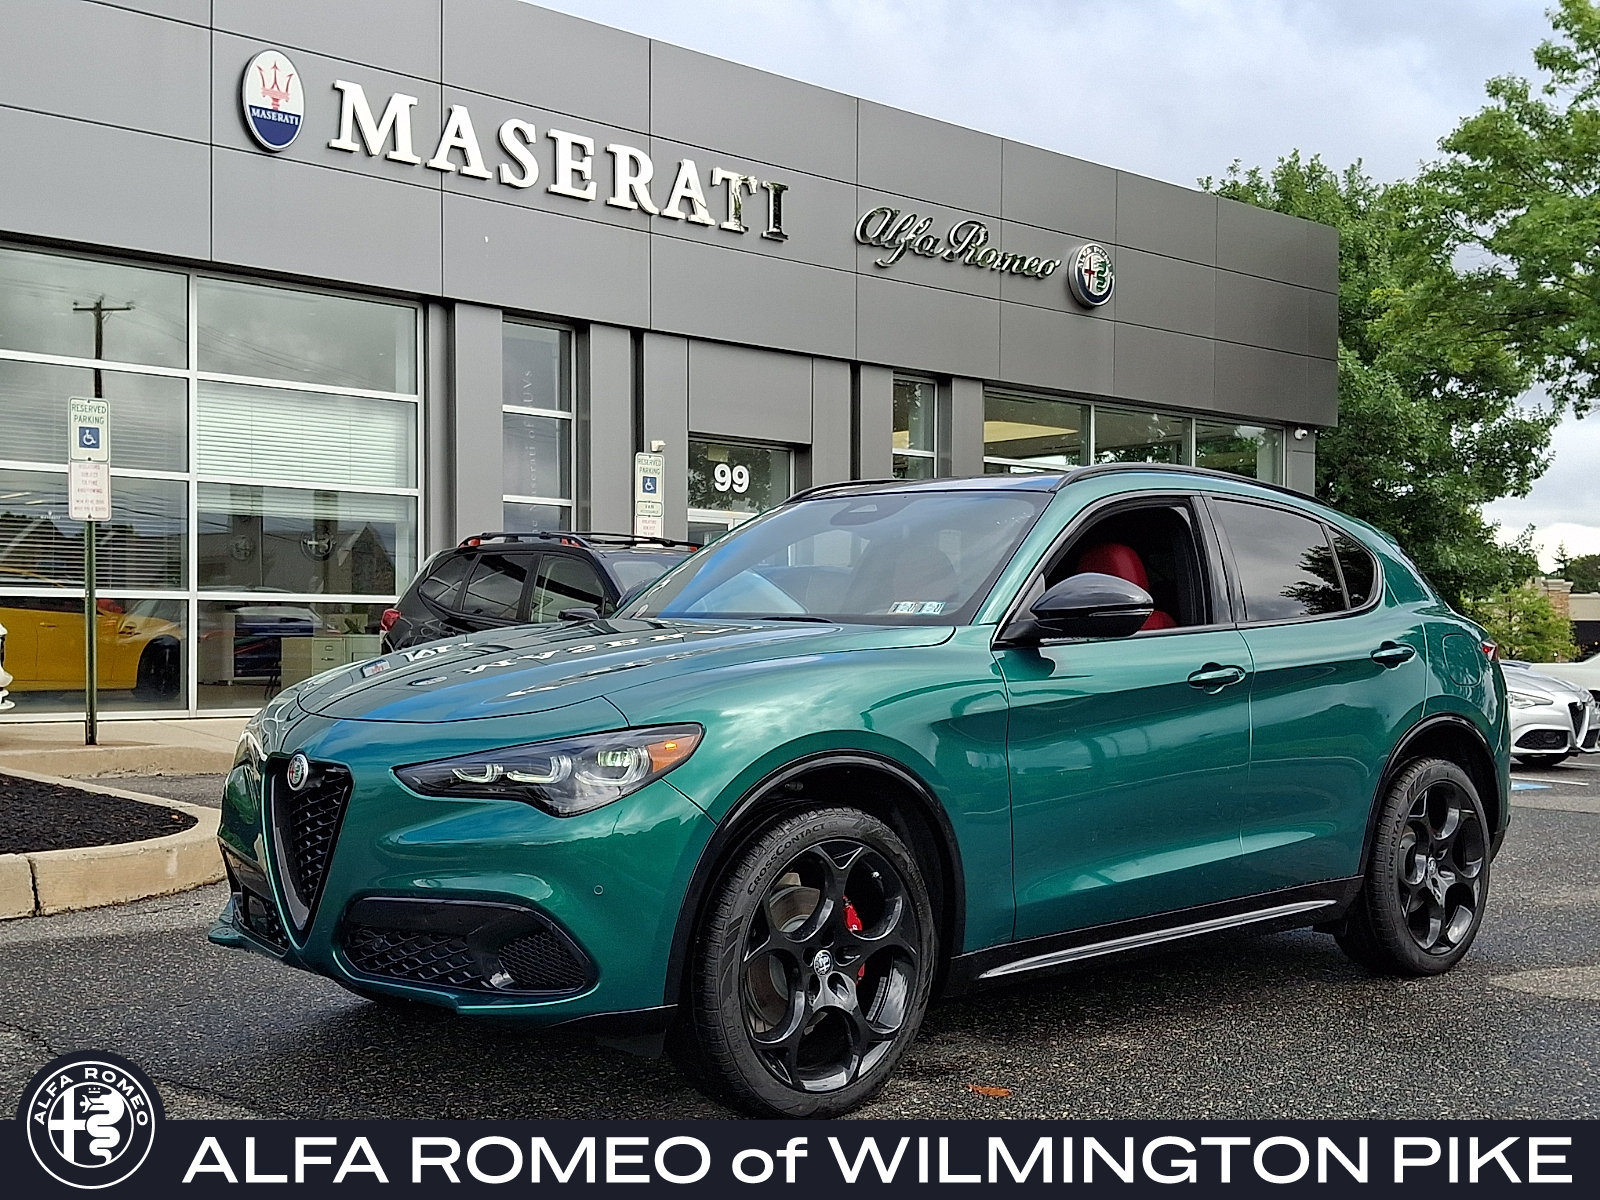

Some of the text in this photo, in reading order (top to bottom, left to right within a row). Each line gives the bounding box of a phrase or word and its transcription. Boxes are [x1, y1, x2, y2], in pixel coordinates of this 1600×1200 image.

[251, 107, 299, 126] MASERATI
[328, 79, 789, 242] MASERATI
[855, 206, 1062, 279] Alfa Romeo
[71, 403, 107, 414] RESERVED
[73, 414, 105, 425] PARKING
[639, 466, 661, 475] PARKING
[713, 463, 750, 494] 99
